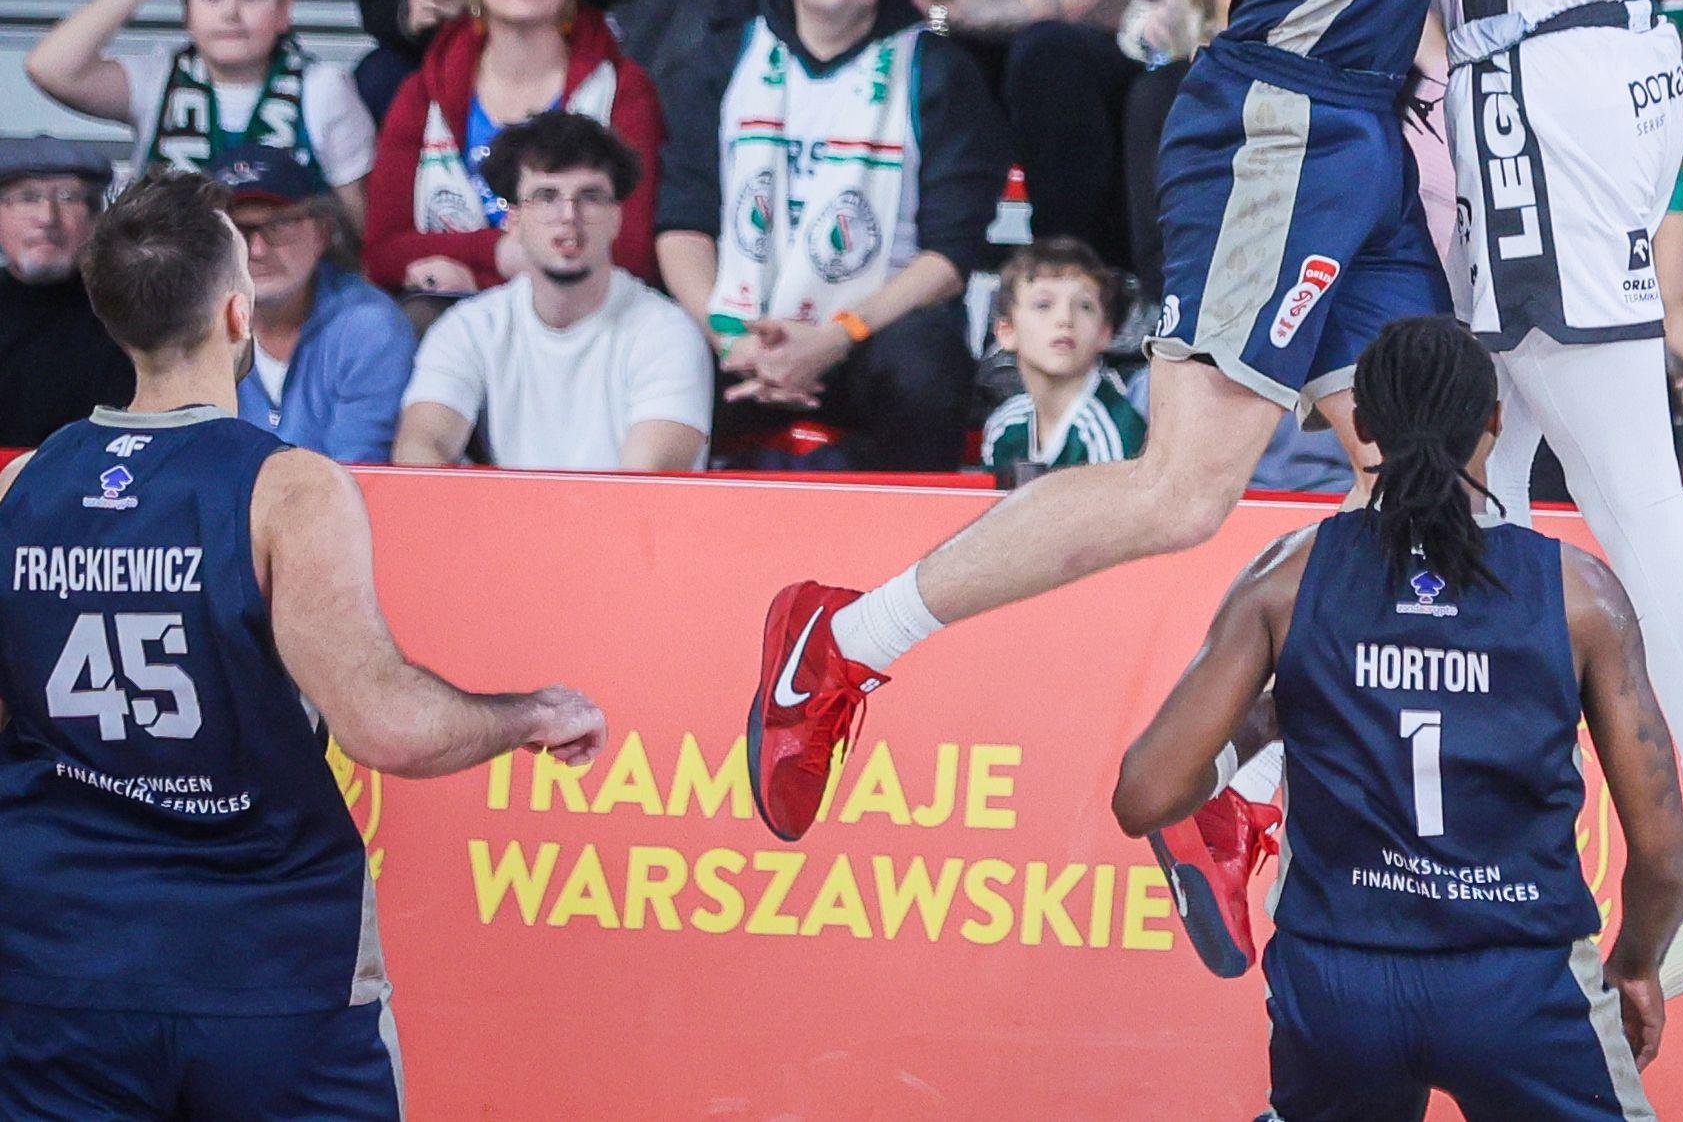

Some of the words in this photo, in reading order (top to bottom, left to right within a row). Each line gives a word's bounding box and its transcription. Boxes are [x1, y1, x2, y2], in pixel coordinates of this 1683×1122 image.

[106, 434, 153, 457] 4F
[13, 546, 203, 599] FRĄCKIEWICZ
[45, 612, 203, 741] 45
[1355, 642, 1490, 694] HORTON
[1400, 709, 1444, 837] 1
[469, 838, 1175, 952] WARSZAWSKIE
[1352, 868, 1441, 901] FINANCIAL
[1447, 881, 1540, 903] SERVICES
